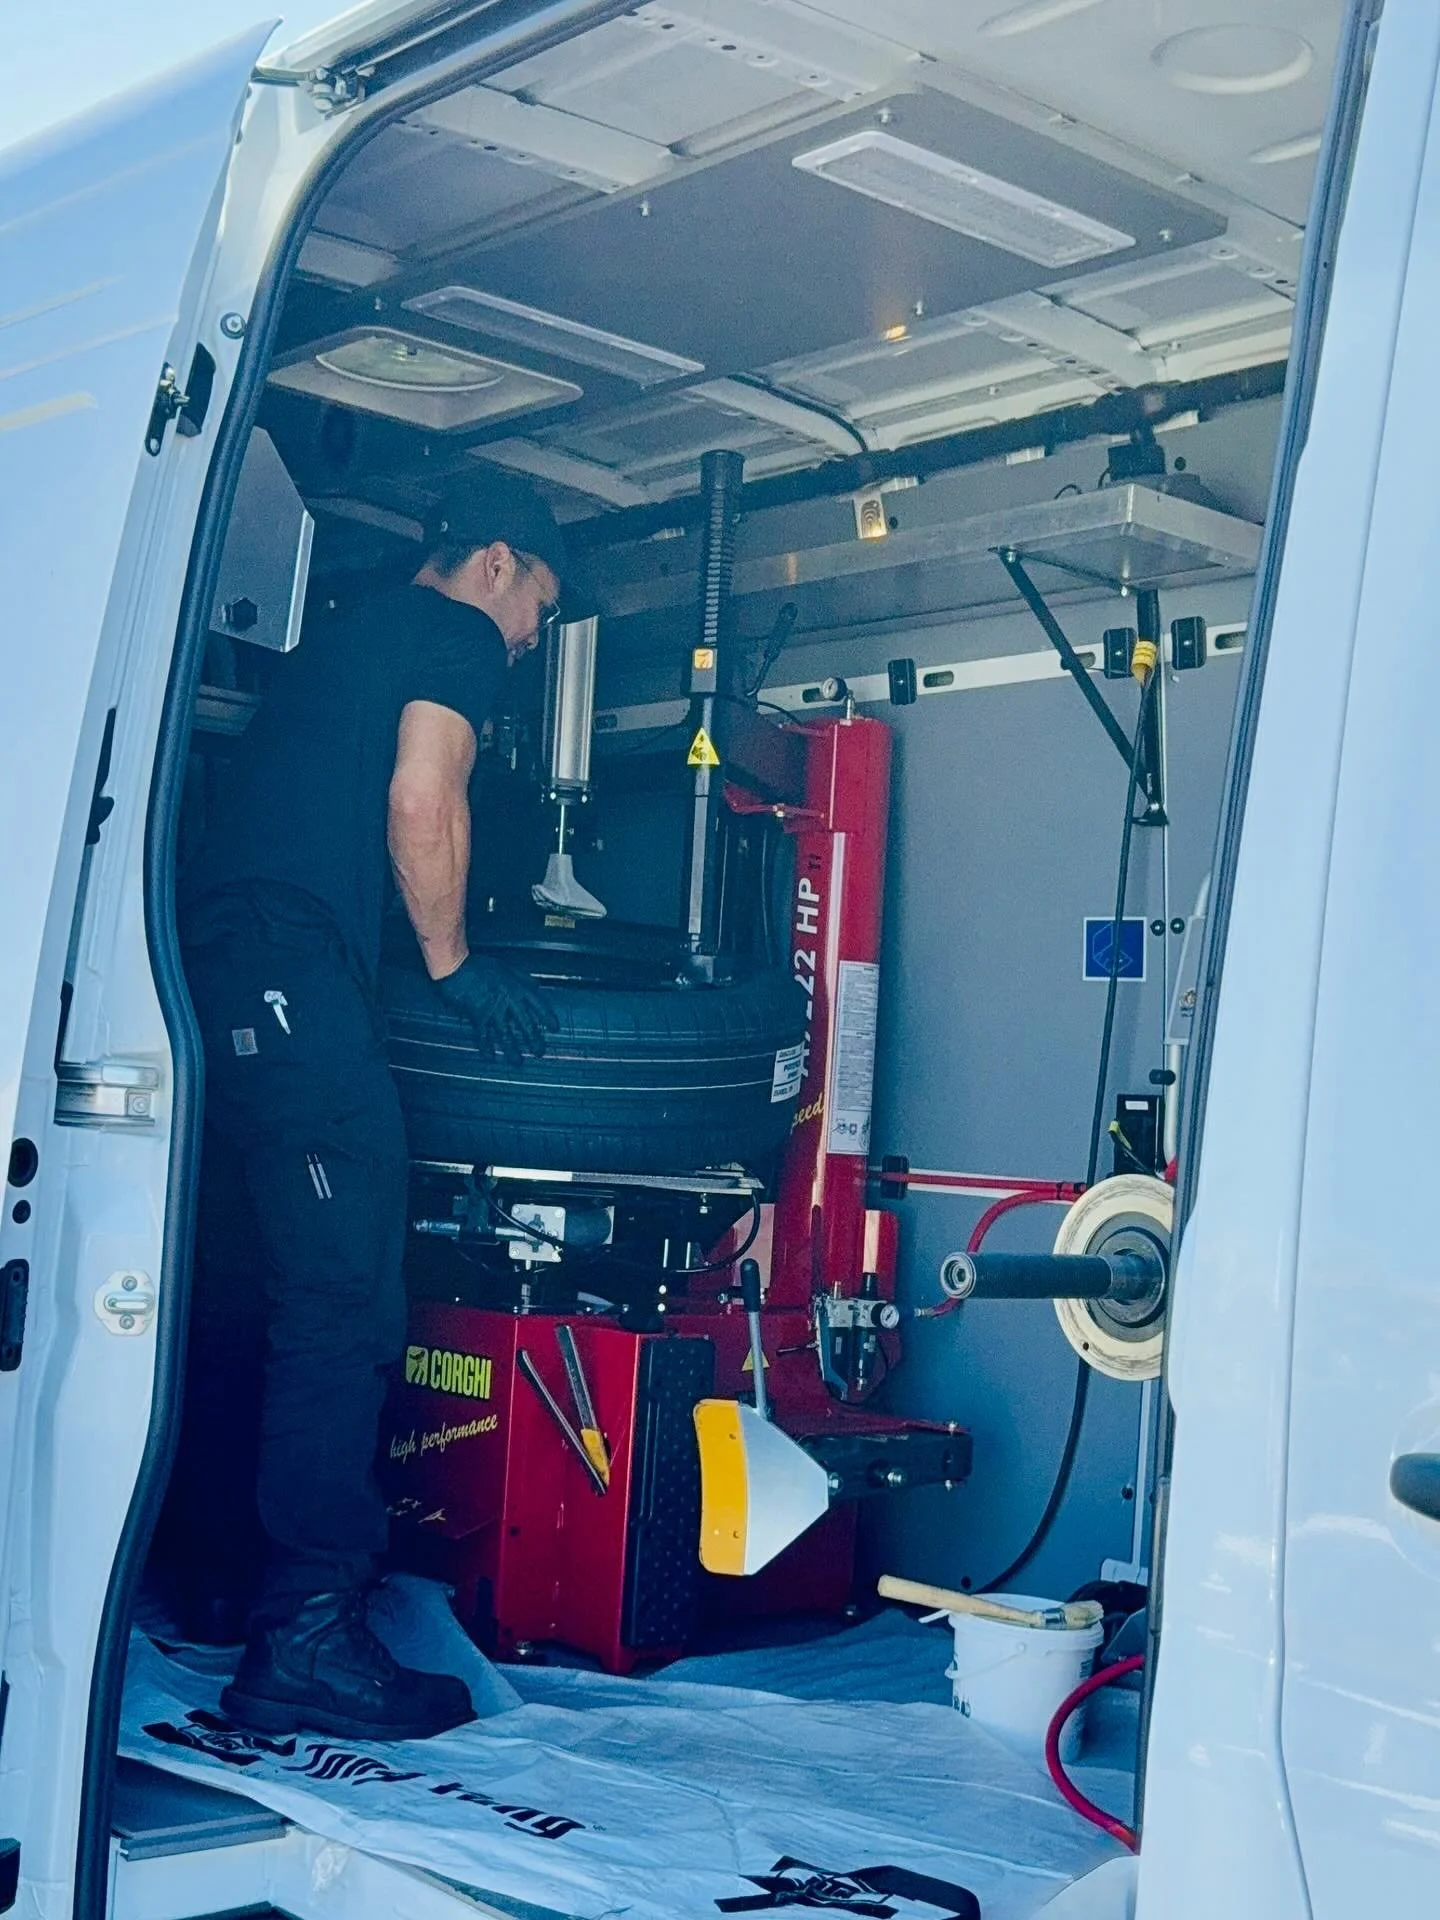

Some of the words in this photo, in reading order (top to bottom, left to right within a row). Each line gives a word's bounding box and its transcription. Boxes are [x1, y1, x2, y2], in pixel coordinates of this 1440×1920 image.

[797, 877, 820, 934] HP
[430, 1349, 492, 1399] CORGHI
[391, 1428, 416, 1463] high
[421, 1414, 498, 1456] performance
